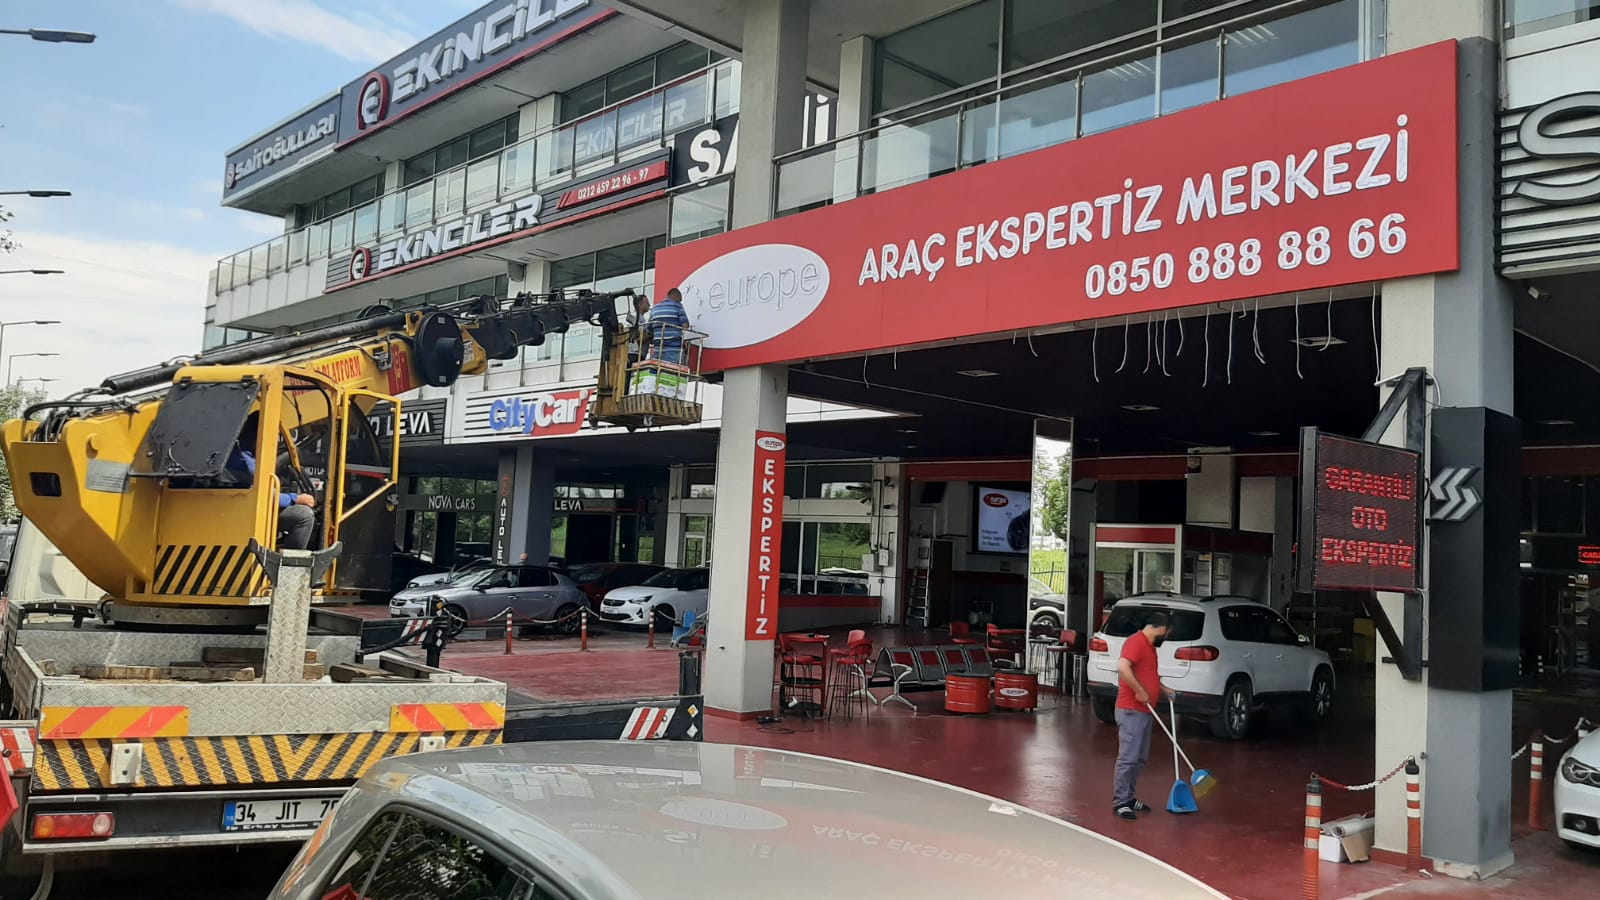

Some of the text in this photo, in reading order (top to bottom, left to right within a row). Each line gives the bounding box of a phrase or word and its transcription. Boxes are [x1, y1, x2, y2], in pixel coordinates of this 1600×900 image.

[578, 185, 594, 200] 0212
[596, 181, 609, 193] 659
[611, 177, 620, 189] 22
[622, 174, 631, 185] 96
[639, 168, 649, 180] 97
[858, 114, 1408, 285] ARAÇ EKSPERTİZ MERKEZİ
[1085, 213, 1407, 299] 0850 888 88 66
[708, 262, 821, 311] europe
[386, 411, 431, 436] LEVA
[489, 393, 580, 434] CityCar
[428, 495, 475, 510] NOVA CARS
[499, 498, 507, 536] AUTO
[554, 500, 581, 511] LEVA
[1351, 505, 1388, 530] OTO
[755, 459, 775, 634] EKSPERTİZ
[1322, 538, 1413, 567] EKSPERTİZ
[236, 804, 256, 822] 34
[275, 802, 301, 820] JIT
